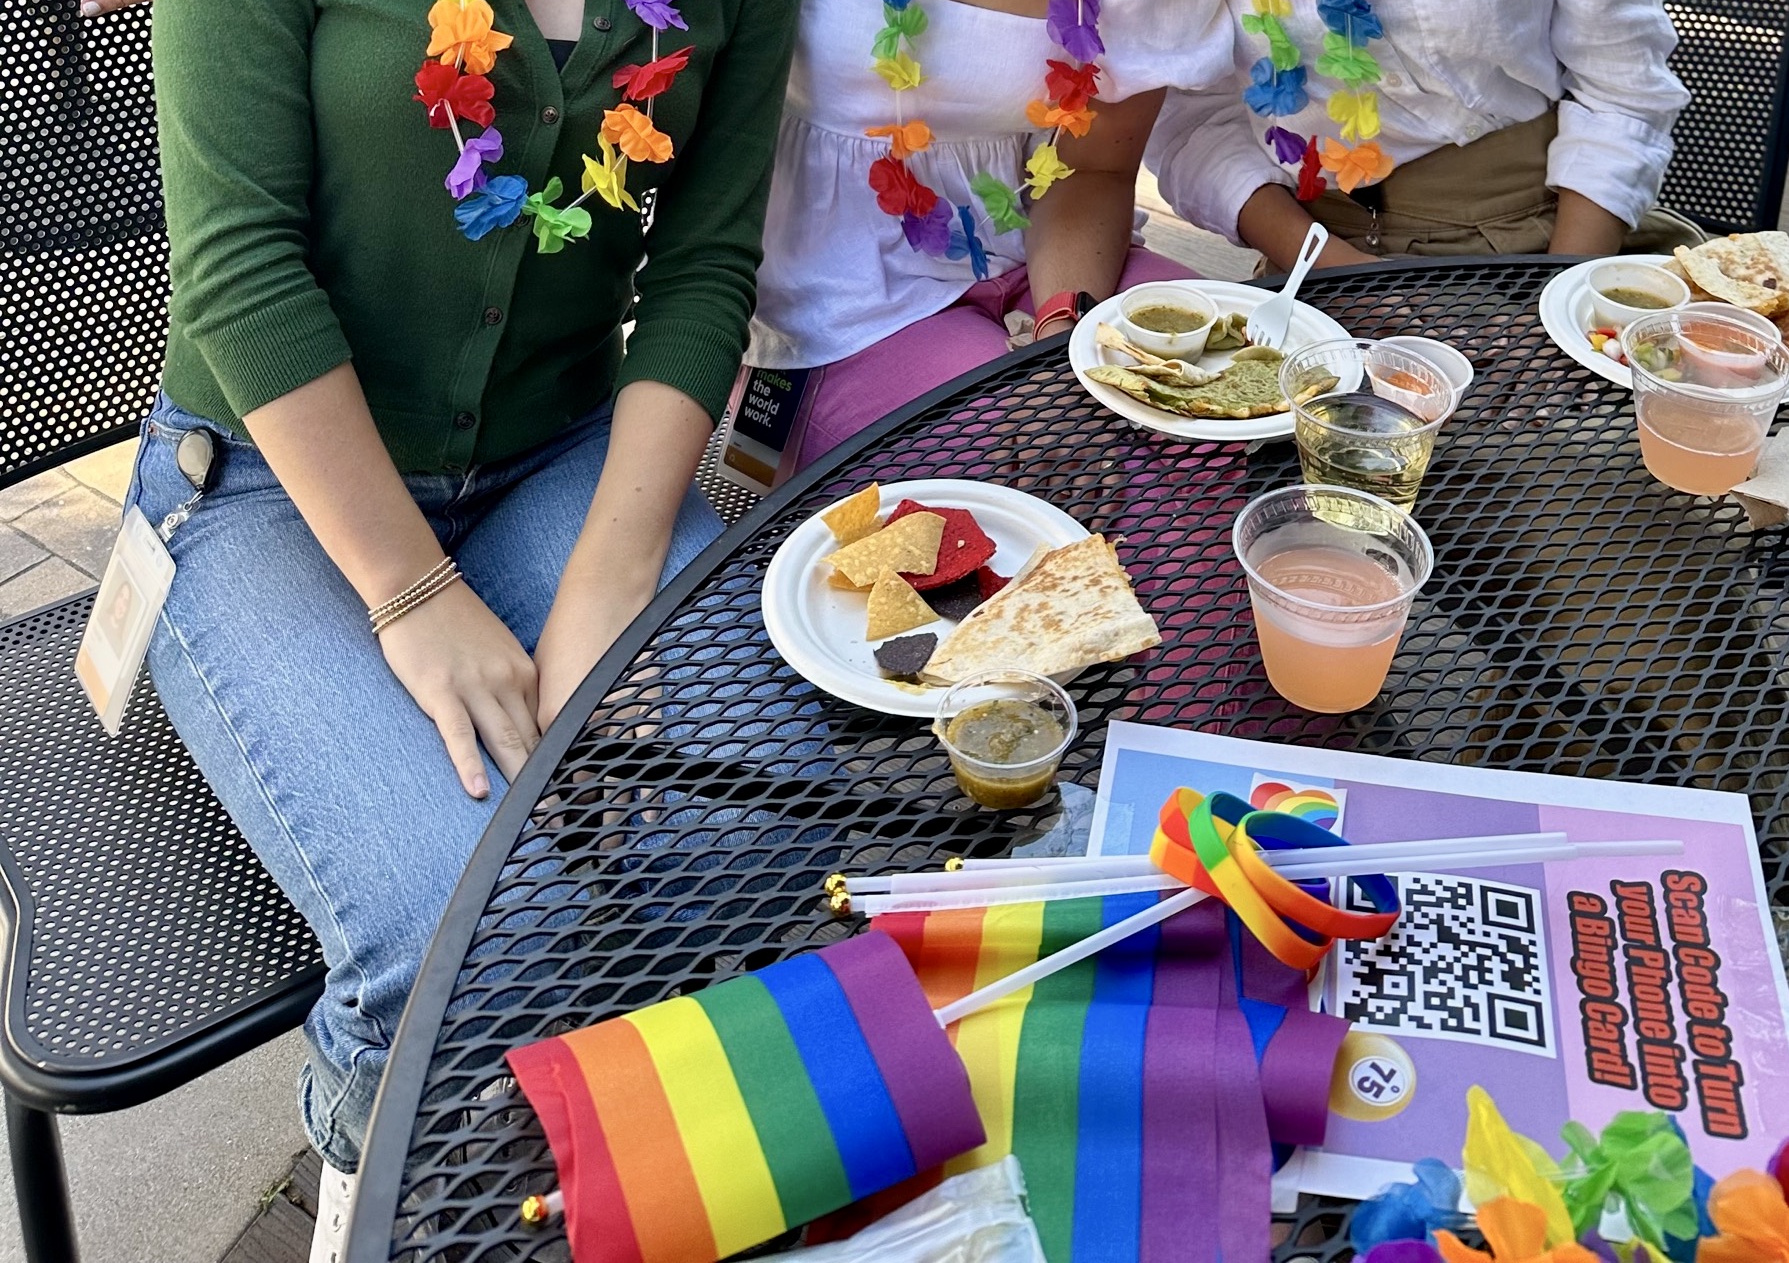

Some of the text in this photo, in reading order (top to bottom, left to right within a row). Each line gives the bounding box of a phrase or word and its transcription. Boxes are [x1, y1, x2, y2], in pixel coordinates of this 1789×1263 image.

[753, 379, 771, 397] the
[757, 370, 792, 391] makes
[744, 406, 772, 428] work.
[748, 393, 780, 415] world
[1570, 893, 1635, 1088] a Bingo Card!
[1612, 881, 1687, 1109] your Phone into
[1662, 871, 1746, 1138] Scan Code to Turn
[1357, 1061, 1397, 1099] 75
